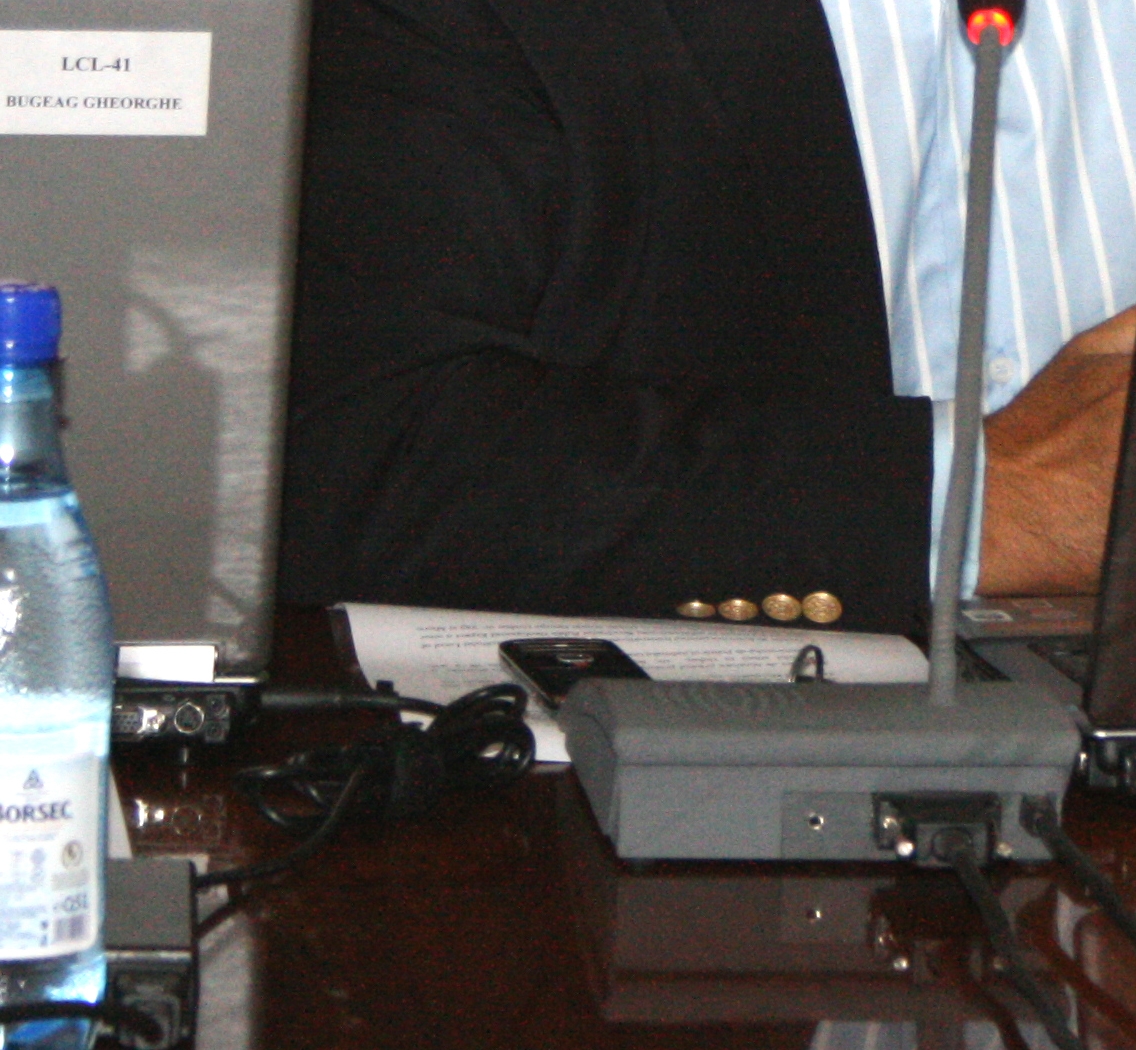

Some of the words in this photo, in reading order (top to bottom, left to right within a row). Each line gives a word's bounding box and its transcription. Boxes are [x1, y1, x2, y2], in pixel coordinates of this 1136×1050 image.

[61, 56, 131, 72] LCL-41
[6, 95, 79, 108] BUGEAG
[83, 96, 183, 110] GHEORGHE
